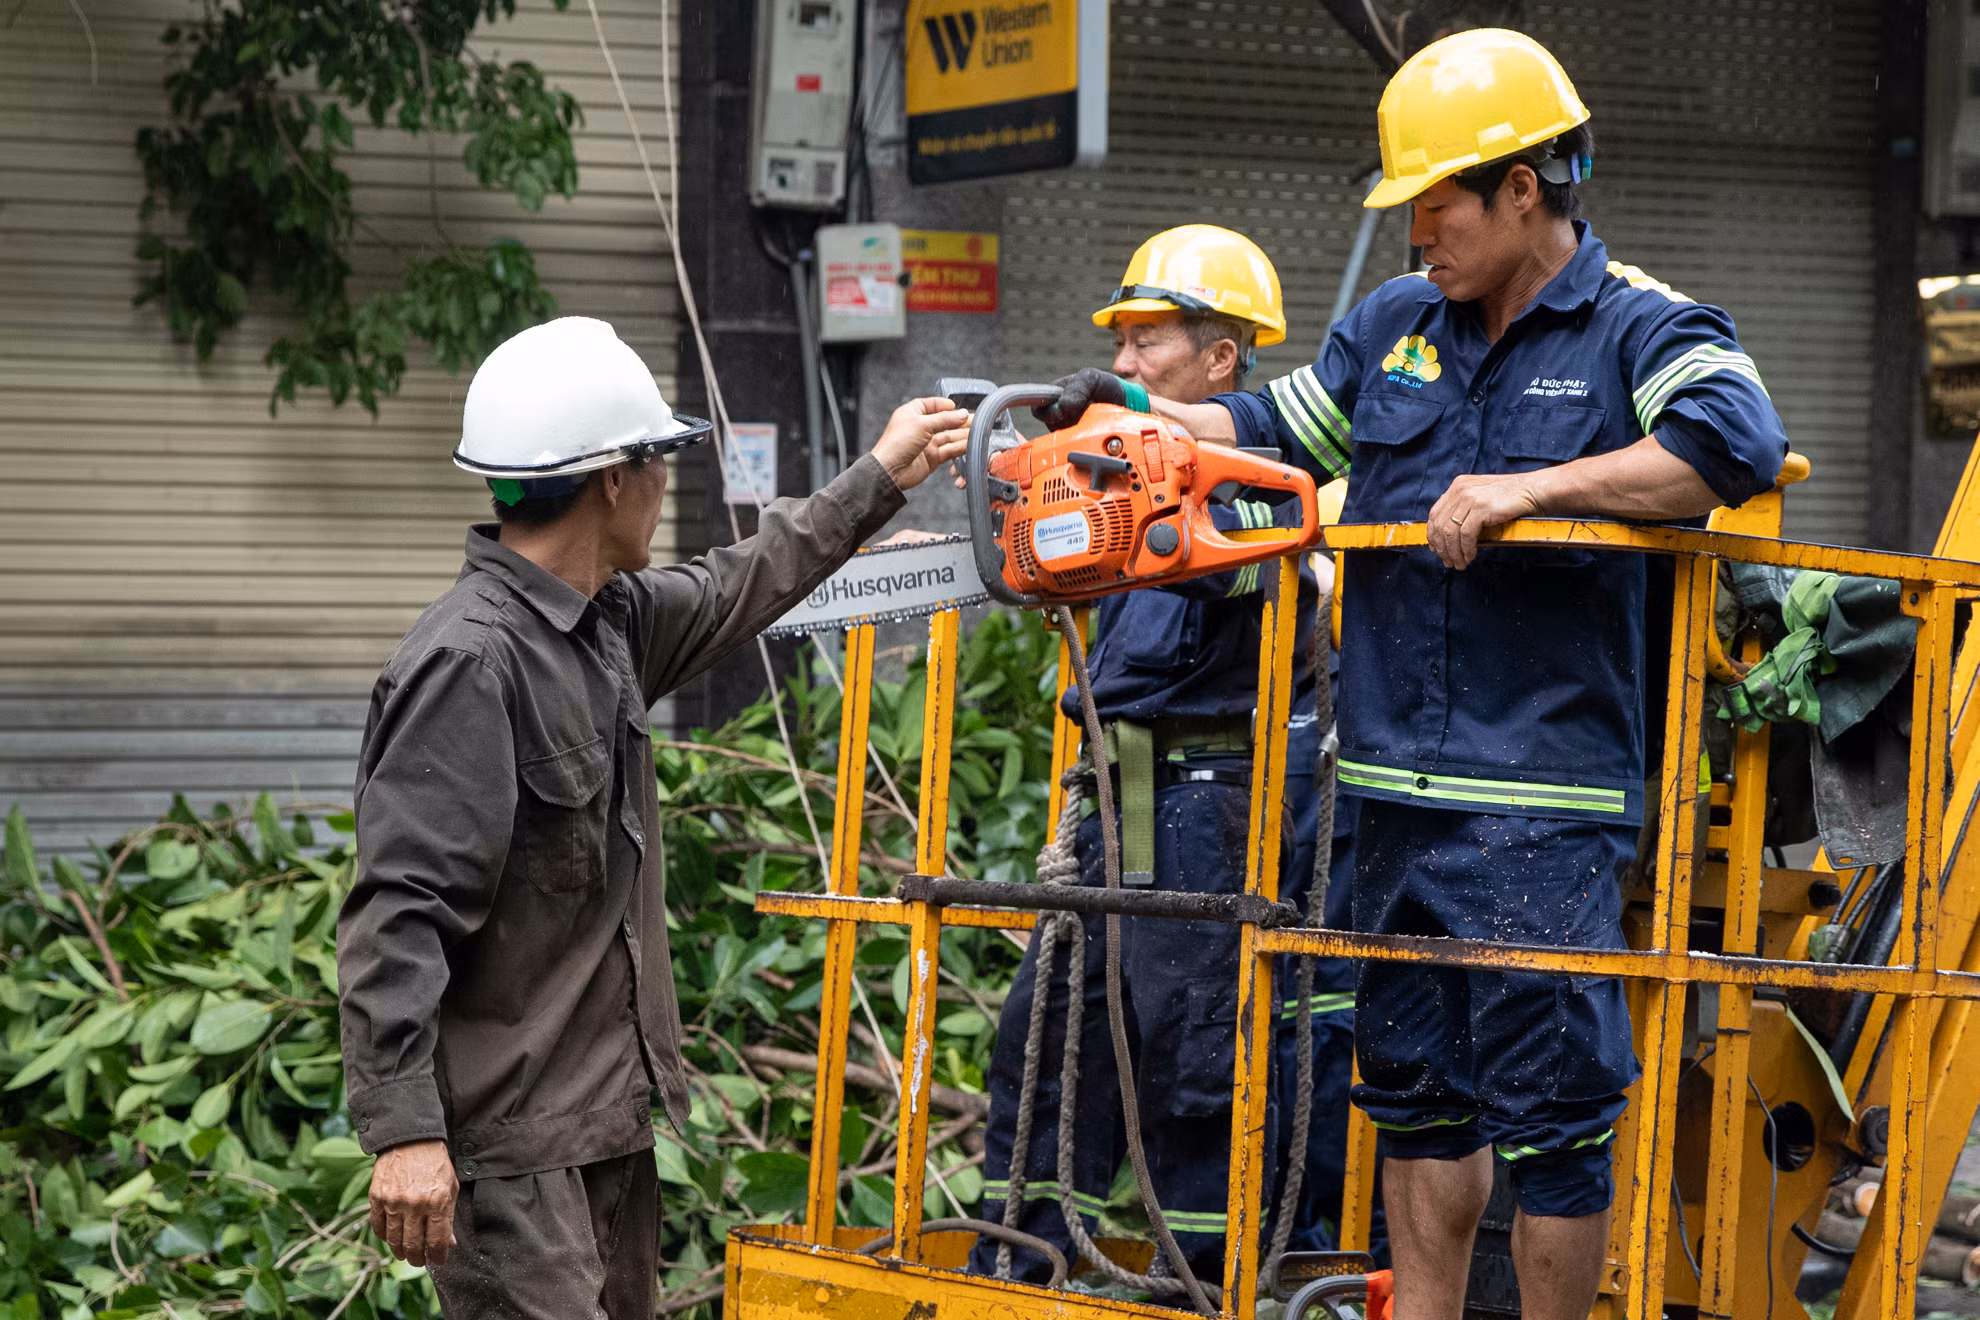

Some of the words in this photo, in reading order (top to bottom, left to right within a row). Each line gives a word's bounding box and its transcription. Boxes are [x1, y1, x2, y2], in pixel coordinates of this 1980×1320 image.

[982, 2, 1052, 33] Western
[982, 38, 1032, 68] Union
[1541, 379, 1562, 389] ĐỨC
[831, 565, 955, 601] Husqvarna
